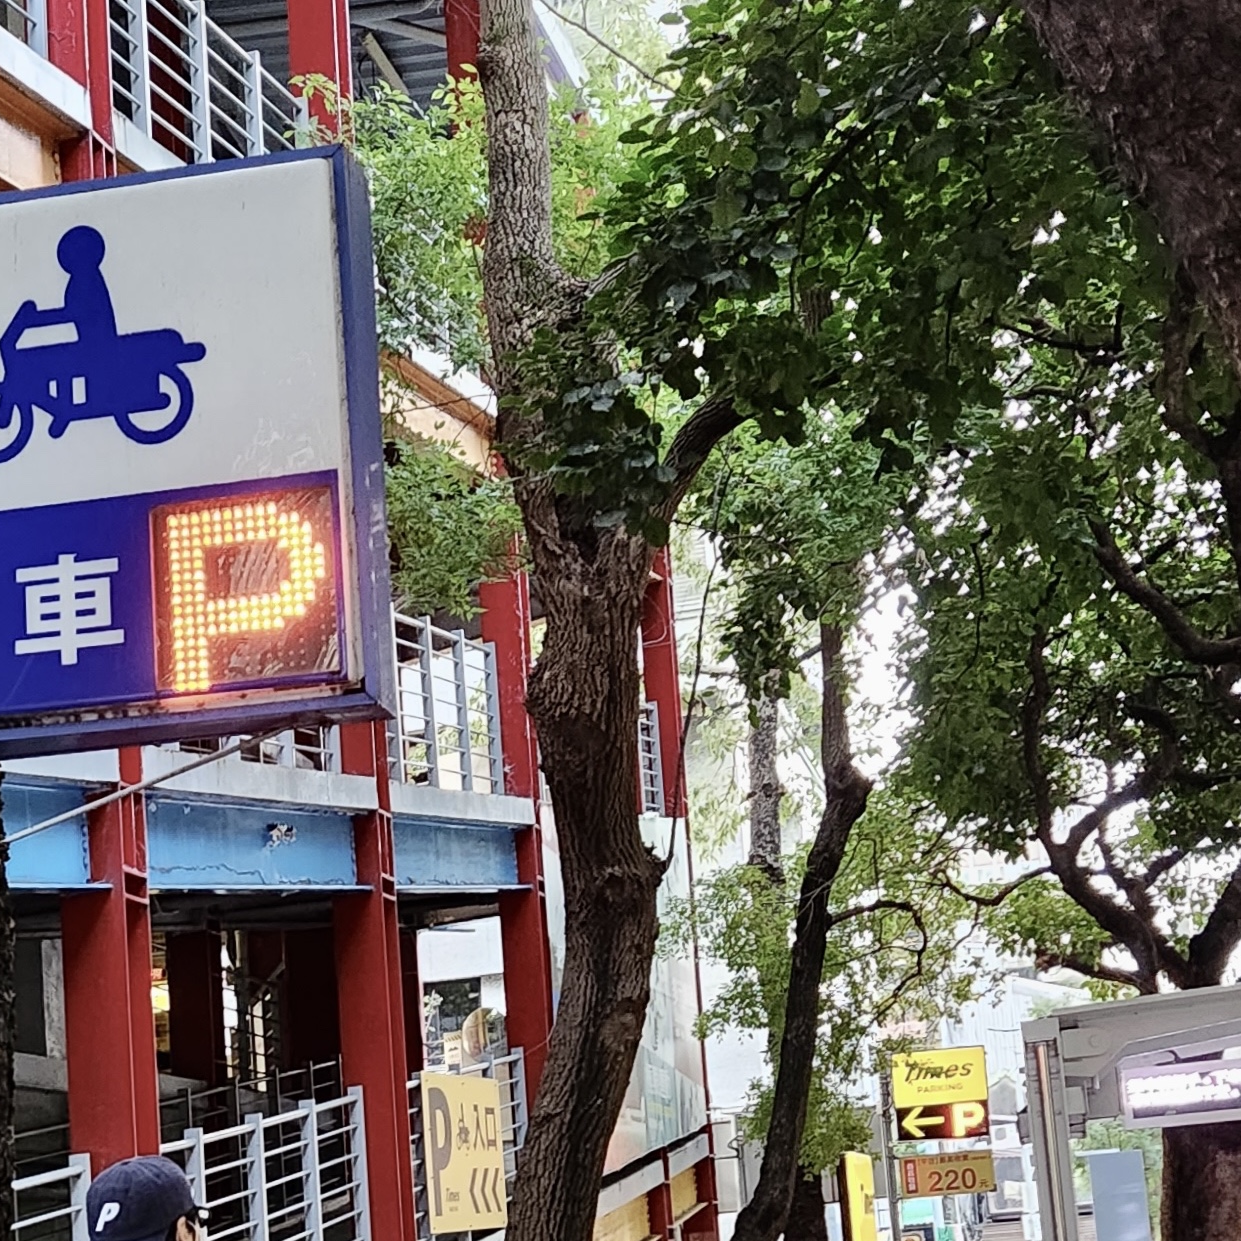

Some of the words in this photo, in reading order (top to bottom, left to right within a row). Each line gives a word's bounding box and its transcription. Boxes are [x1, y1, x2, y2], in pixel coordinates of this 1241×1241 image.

[166, 501, 326, 692] P
[952, 1102, 985, 1137] P
[428, 1087, 453, 1217] P
[928, 1168, 977, 1192] 220
[95, 1202, 120, 1232] P
